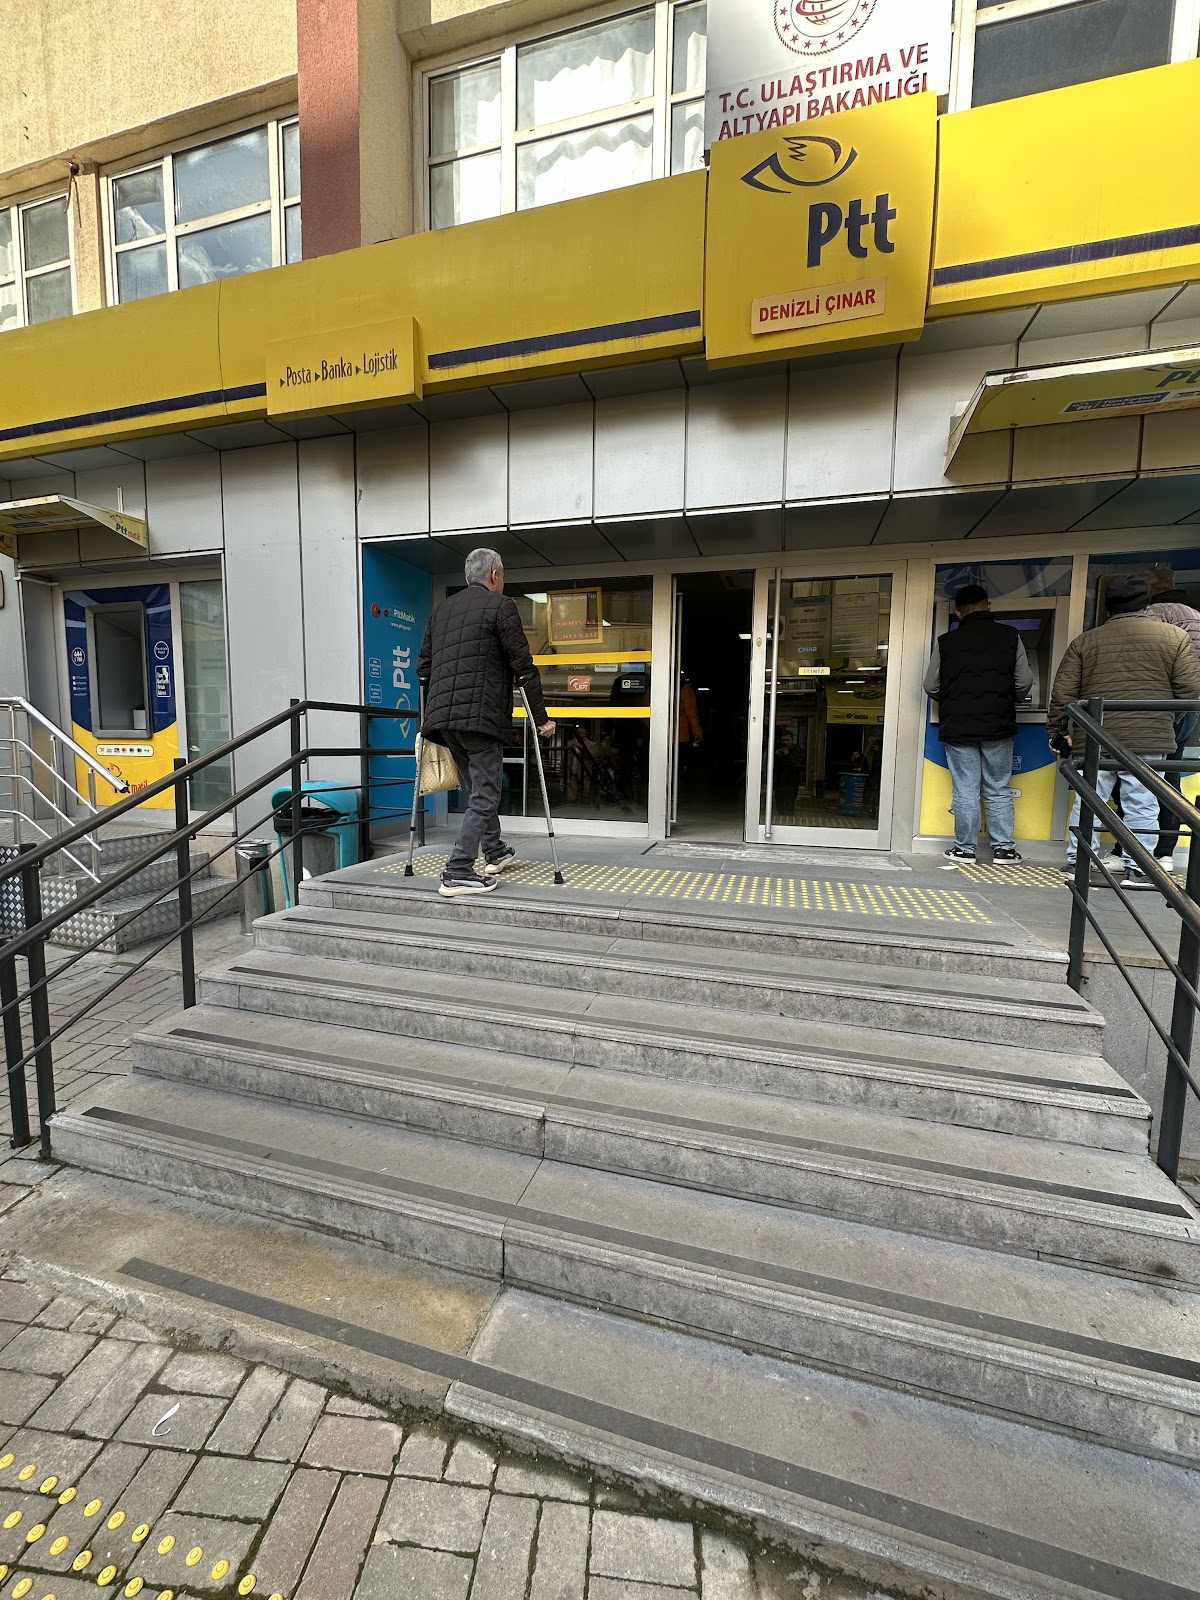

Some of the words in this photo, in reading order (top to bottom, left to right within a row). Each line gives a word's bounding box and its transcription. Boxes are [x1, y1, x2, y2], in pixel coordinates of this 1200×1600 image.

[718, 103, 801, 141] ALTYAPI
[807, 69, 928, 120] BAKANLIĞI
[719, 88, 754, 113] T.C.
[761, 52, 892, 97] ULAŞTIRMA
[899, 42, 929, 69] VE
[807, 193, 897, 268] Ptt
[759, 295, 820, 322] DENİZLİ
[825, 289, 876, 315] ÇINAR
[286, 366, 312, 387] Posta
[321, 357, 353, 381] Banka
[363, 348, 398, 378] Lojistik
[393, 645, 411, 690] Ptt
